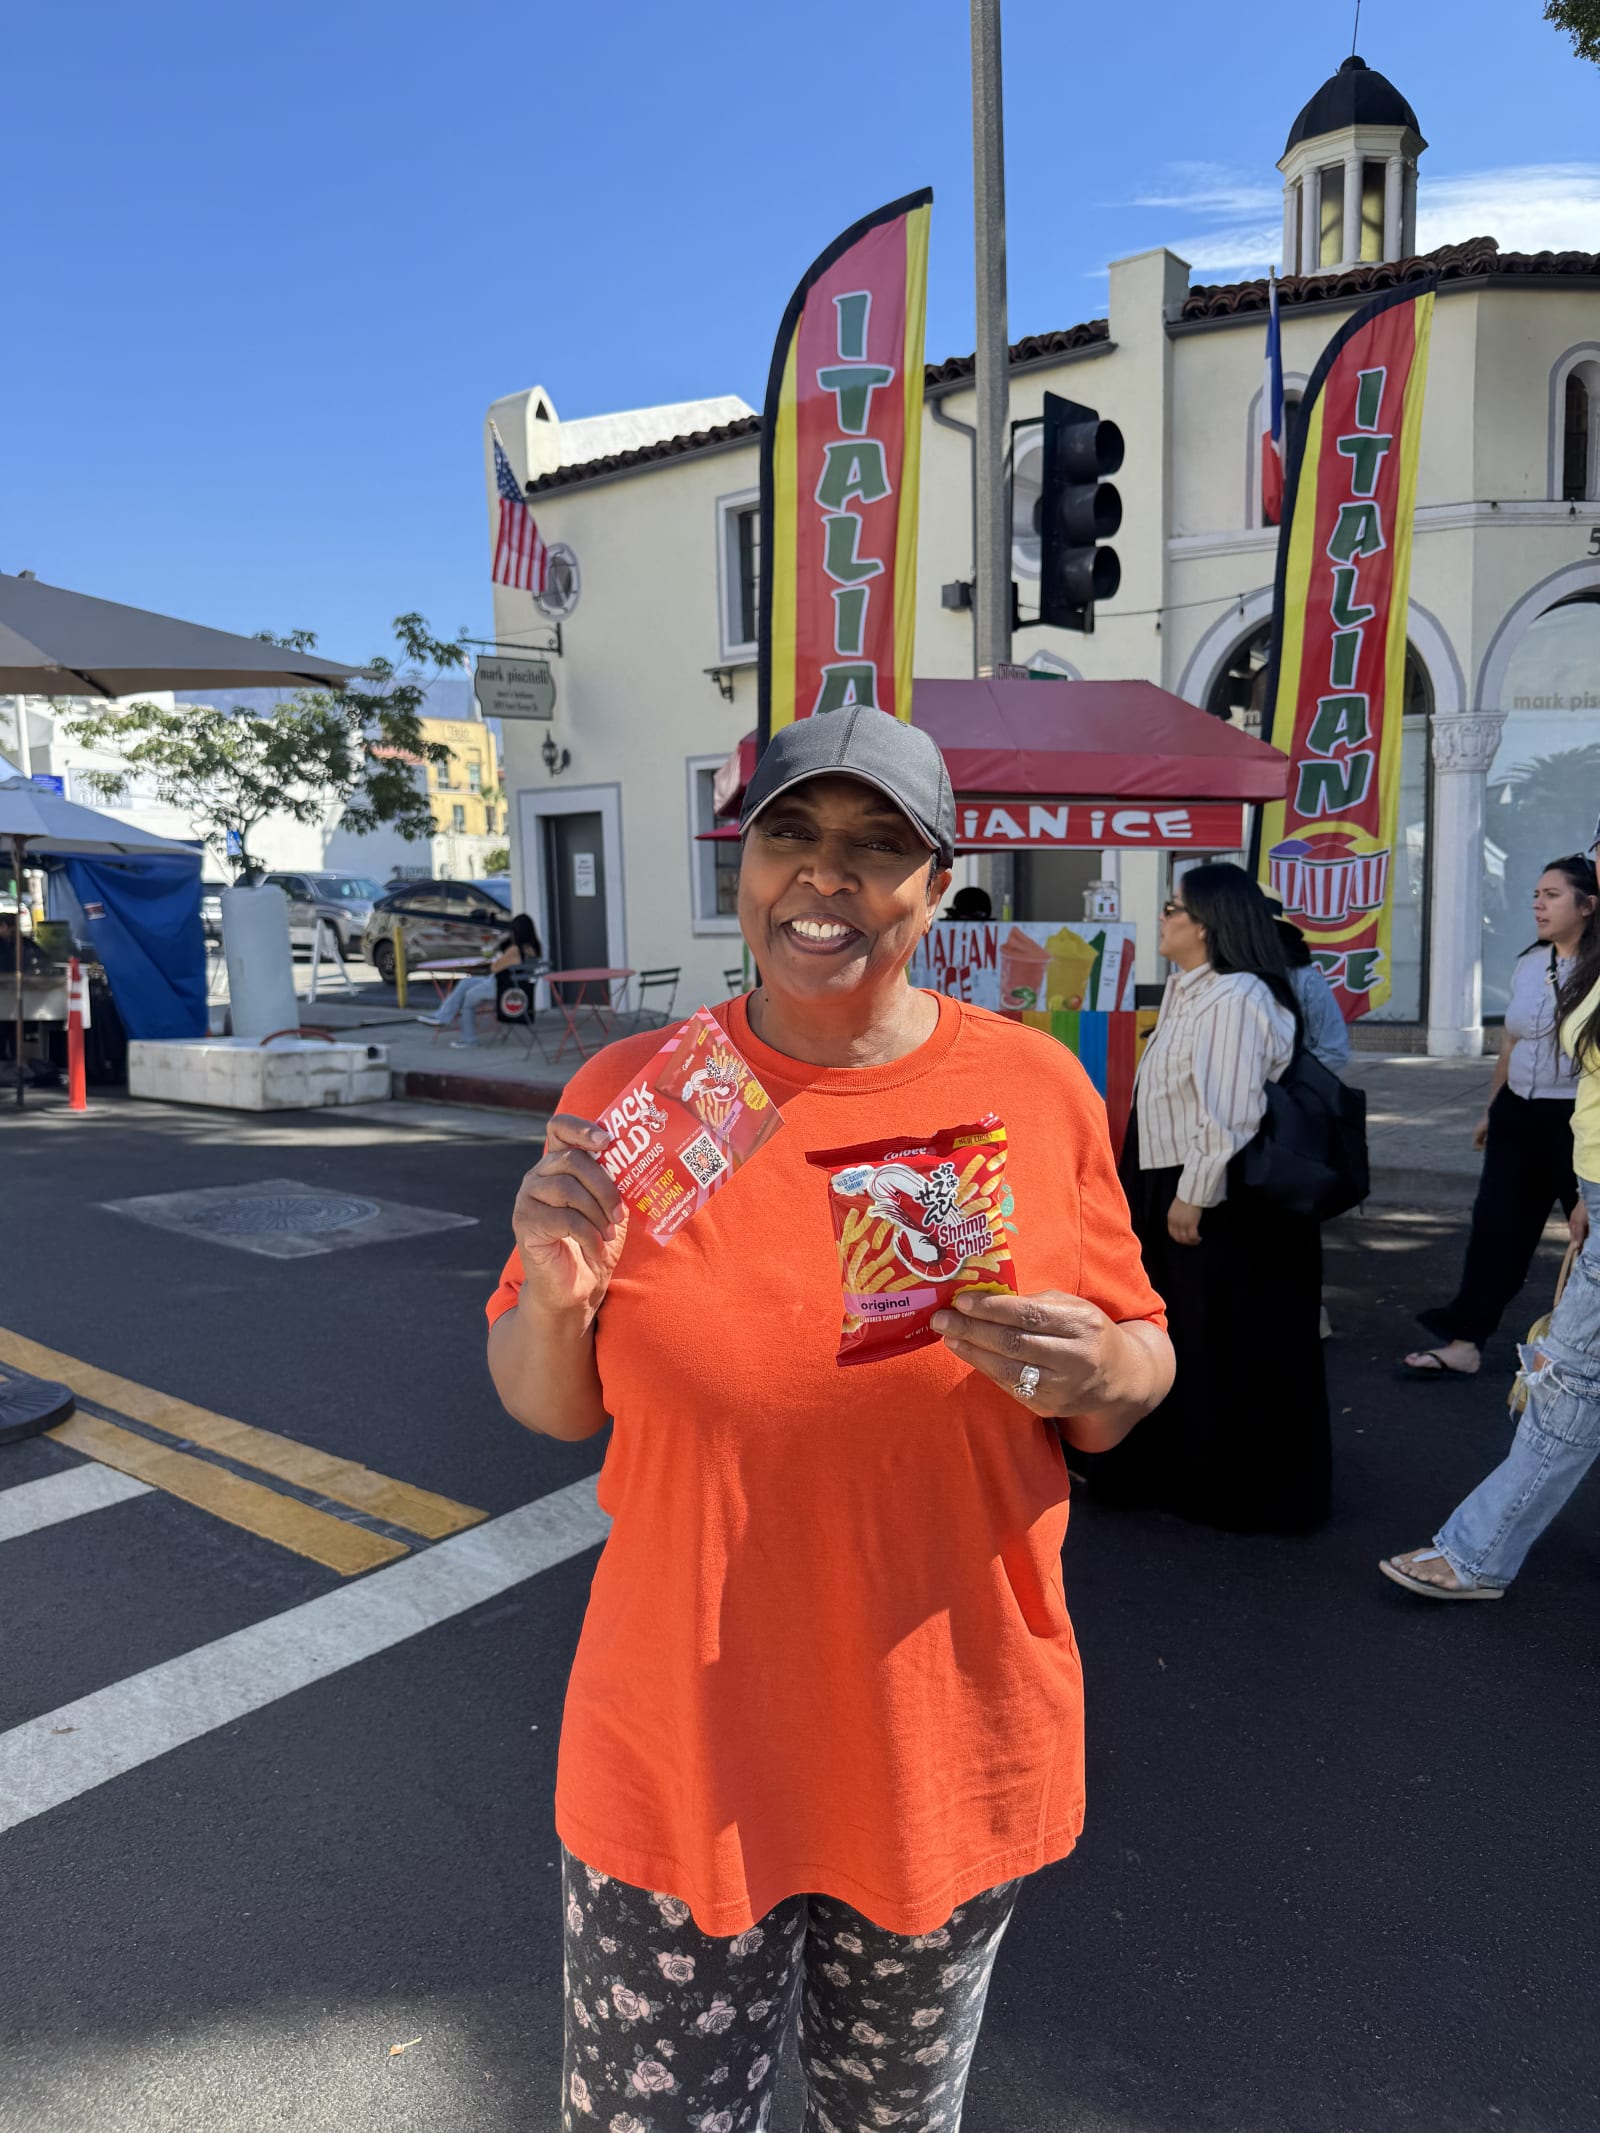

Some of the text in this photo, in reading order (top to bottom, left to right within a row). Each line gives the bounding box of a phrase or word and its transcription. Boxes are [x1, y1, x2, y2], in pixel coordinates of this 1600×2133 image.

[1295, 366, 1393, 818] ITALIAN
[1513, 690, 1600, 712] mark pis
[955, 806, 1069, 839] iAN
[1310, 947, 1386, 993] CE
[604, 1081, 655, 1141] ACK
[601, 1125, 651, 1182] WILD
[617, 1173, 634, 1194] STAY
[631, 1143, 664, 1178] CURIOUS
[636, 1194, 654, 1213] WIN
[649, 1188, 660, 1200] A
[655, 1168, 675, 1192] TRIP
[647, 1206, 661, 1221] TO
[658, 1182, 684, 1212] JAPAN
[939, 1214, 987, 1245] Shrimp
[956, 1231, 992, 1258] Chips
[860, 1296, 911, 1312] original
